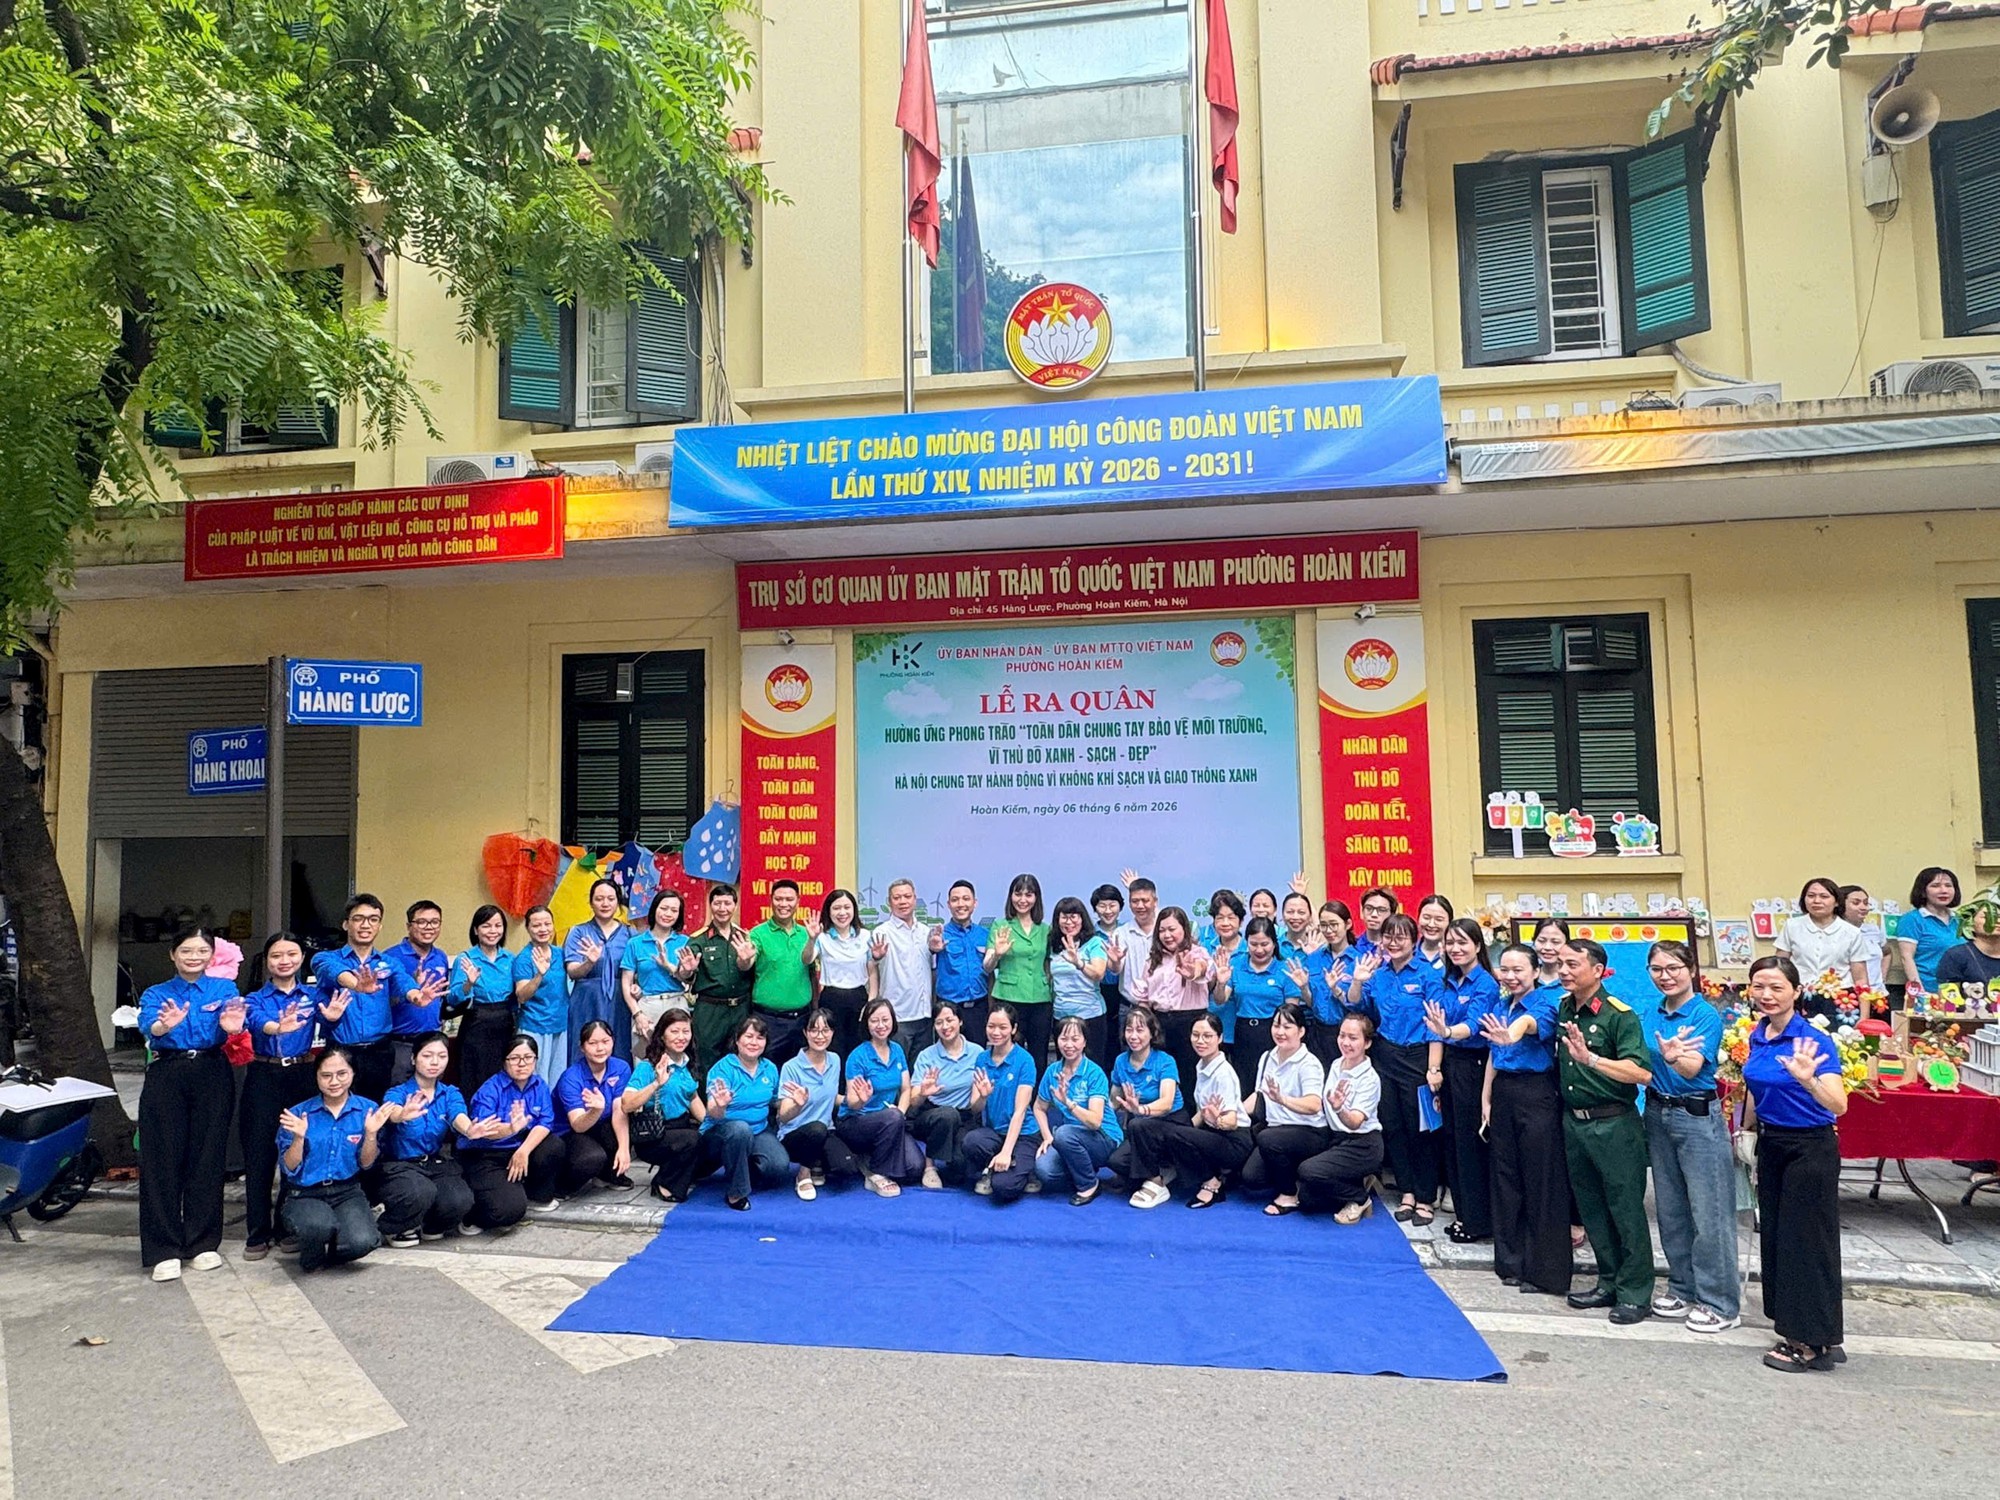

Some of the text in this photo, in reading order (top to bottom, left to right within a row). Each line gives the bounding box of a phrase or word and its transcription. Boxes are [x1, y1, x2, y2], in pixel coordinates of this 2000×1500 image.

[1018, 288, 1096, 320] MẶT TRẬN TỔ QUỐC
[1038, 367, 1084, 381] VIỆT NAM
[736, 403, 1363, 471] NHIỆT LIỆT CHÀO MỪNG ĐẠI HỘI CÔNG ĐOÀN VIỆT NAM
[831, 467, 875, 500] LẦN
[882, 467, 928, 497] THỨ
[932, 468, 972, 496] XIV,
[979, 461, 1057, 495] NHIỆM
[1064, 456, 1095, 486] KỲ
[1101, 456, 1160, 484] 2026
[273, 494, 469, 521] NGHIÊM TÚC CHẤP HÀNH CÁC QUY ĐỊNH
[246, 534, 498, 567] LÀ TRÁCH NHIỆM VÀ NGHĨA VỤ CỦA MỖI CÔNG DÂN
[749, 541, 1406, 611] TRỤ SỞ CƠ QUAN ỦY BAN MẶT TRẬN TỔ QUỐC VIỆT NAM PHƯỜNG HOÀN KIẾM
[950, 596, 1189, 617] Địa chỉ: 45 Hàng Lược, Phường Hoàn Kiếm, Hà Nội
[937, 639, 1194, 660] ỦY BAN NHÂN DÂN ỦY BAN MTTQ VIỆT NAM
[1006, 657, 1123, 673] PHƯỜNG HOÀN KIẾM
[340, 669, 380, 685] PHỐ
[298, 686, 410, 718] HÀNG LƯỢC
[979, 684, 1157, 716] LỄ RA QUÂN
[885, 723, 920, 743] HƯỞNG
[924, 724, 945, 742] ỨNG
[949, 726, 985, 742] PHONG
[988, 722, 1016, 740] TRÀO
[1058, 720, 1080, 739] DÂN
[1084, 722, 1121, 738] CHUNG
[1125, 721, 1145, 737] TAY
[1149, 716, 1171, 736] BẢO
[1174, 717, 1189, 738] VỆ
[1192, 716, 1215, 735] MÔI
[1218, 715, 1267, 735] TRƯỜNG,
[221, 734, 248, 750] PHỐ
[1342, 733, 1408, 755] NHÂN DÂN
[757, 752, 820, 771] TOÀN ĐẢNG,
[989, 746, 1000, 764] VÌ
[1003, 744, 1023, 764] THỦ
[1027, 745, 1042, 764] ĐÔ
[1045, 747, 1075, 764] XANH
[1087, 746, 1116, 765] SẠCH
[194, 757, 265, 783] HÀNG KHOAI
[895, 766, 1258, 792] HÀ NỘI CHUNG TAY HÀNH ĐỘNG VÌ KHÔNG KHÍ SẠCH VÀ GIAO THÔNG XANH
[1353, 766, 1400, 788] THỦ ĐÔ
[761, 777, 815, 795] TOÀN DÂN
[758, 802, 818, 820] TOÀN QUÂN
[970, 801, 1178, 816] Hoàn Kiếm, ngày 06 tháng 6 năm 2026
[1345, 797, 1411, 821] ĐOÀN KẾT,
[759, 825, 816, 847] ĐẨY MẠNH
[1345, 833, 1412, 856] SÁNG TẠO,
[765, 853, 810, 872] HỌC TẬP
[752, 879, 767, 895] VÀ
[1348, 867, 1412, 889] XÂY DỰNG
